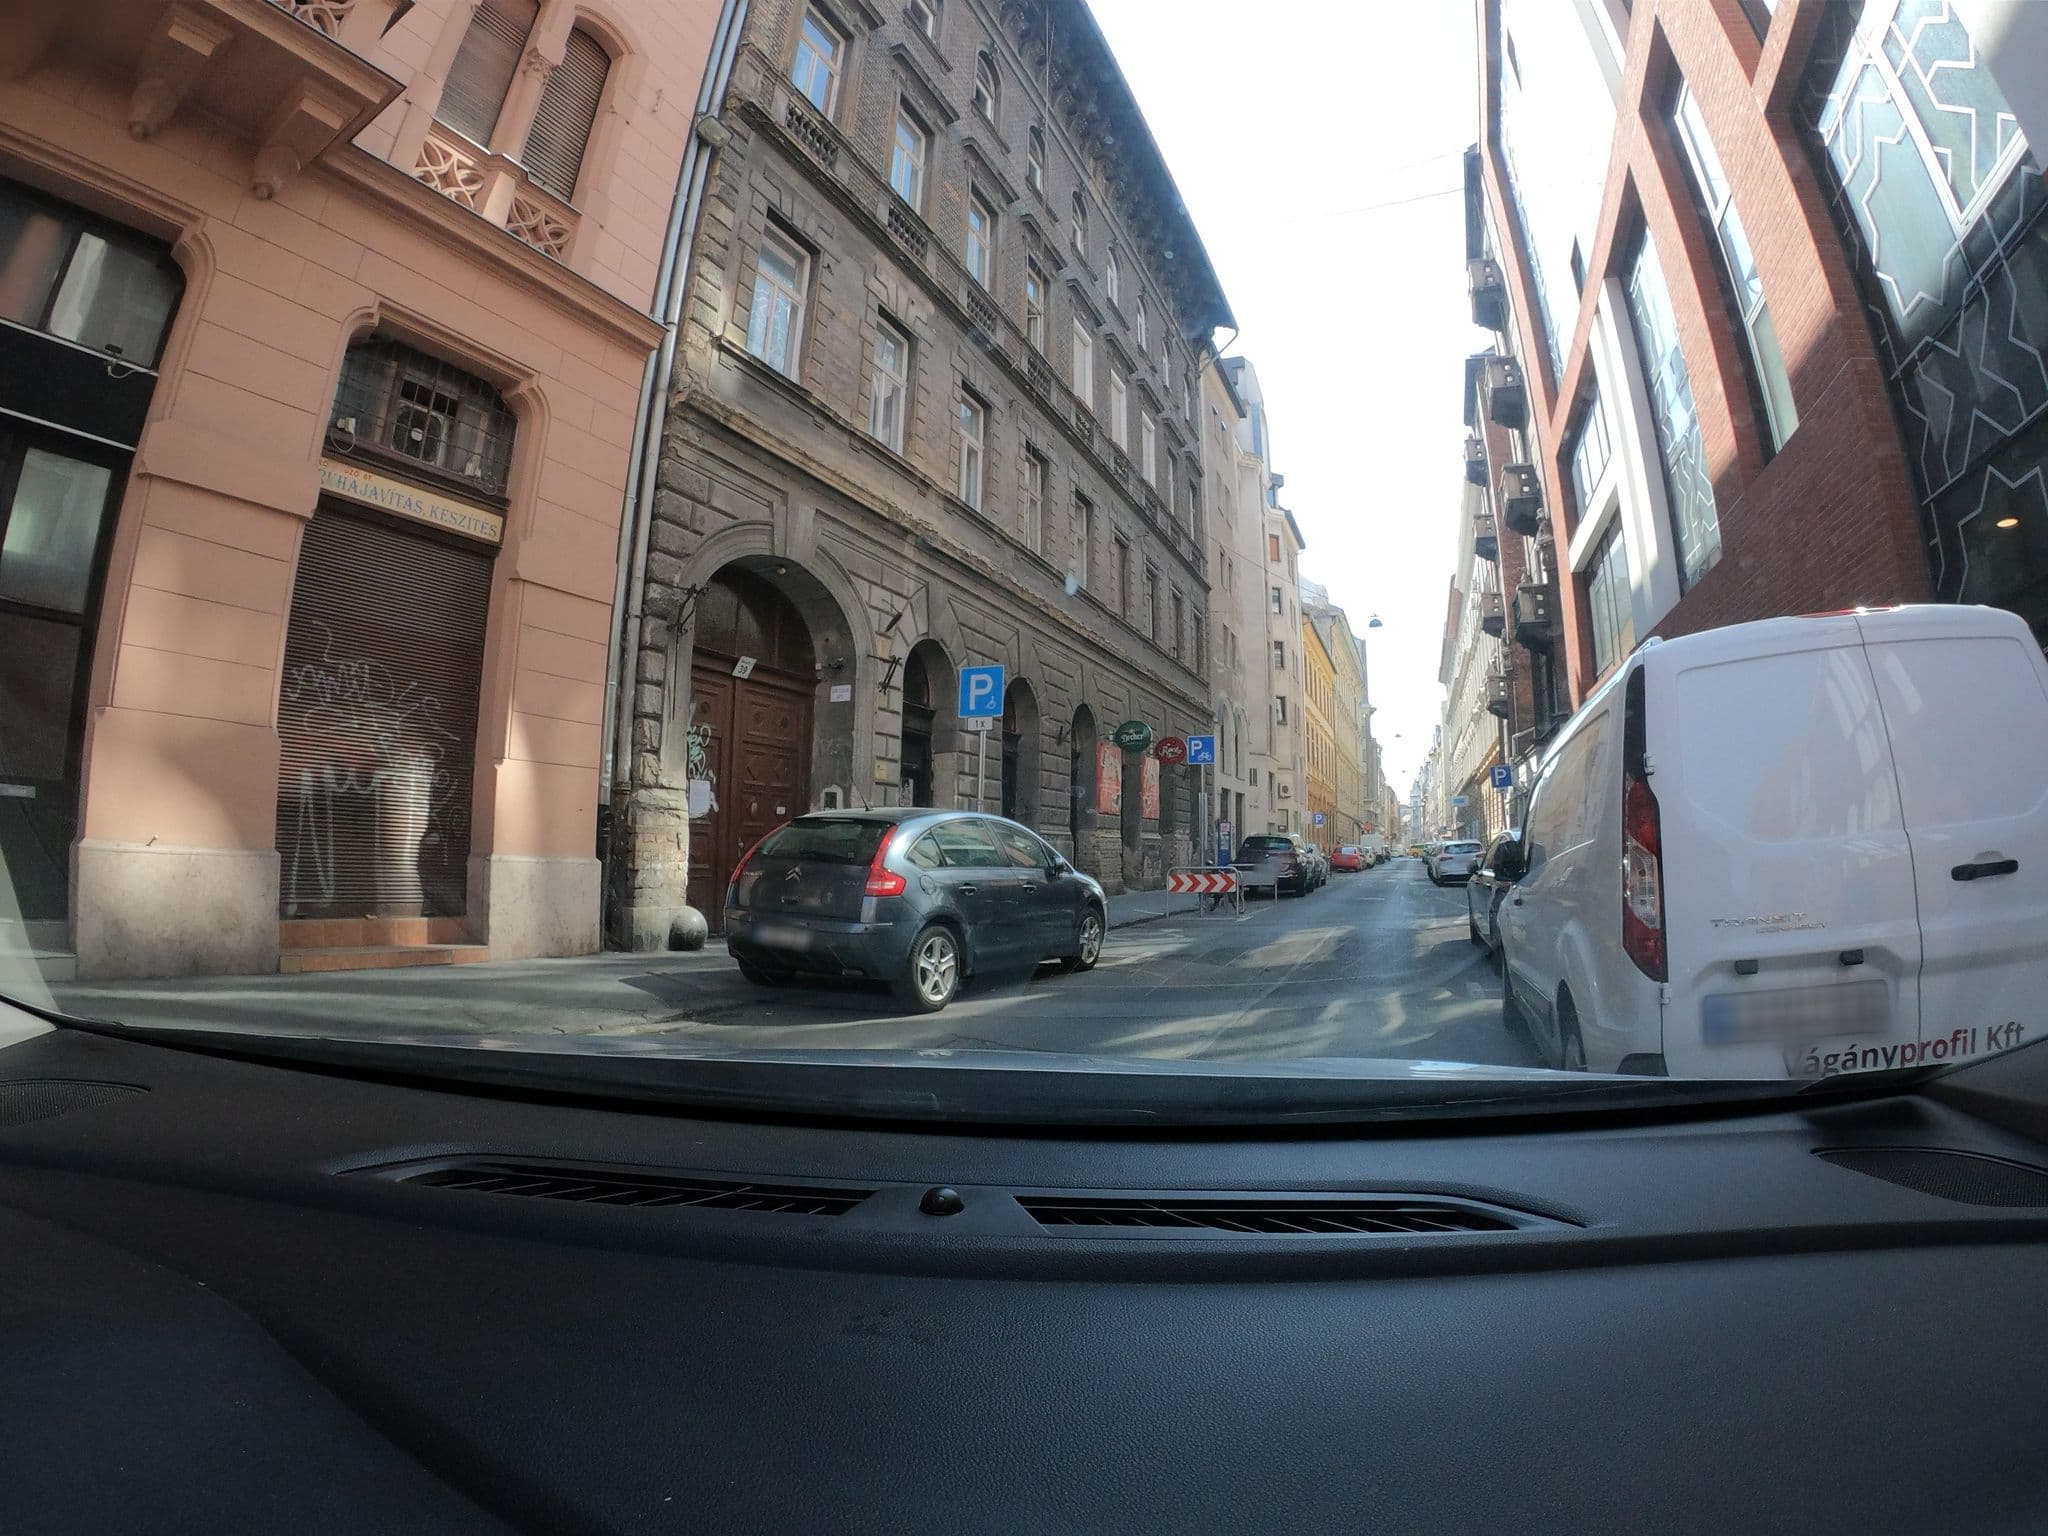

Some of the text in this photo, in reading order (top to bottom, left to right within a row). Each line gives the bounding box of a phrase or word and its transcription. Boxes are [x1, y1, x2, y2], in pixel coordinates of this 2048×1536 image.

[430, 502, 498, 538] KÉSZÍTÉS
[969, 673, 993, 711] P
[1191, 740, 1203, 756] P
[1494, 767, 1507, 786] P
[1315, 814, 1323, 823] P
[1986, 1020, 2026, 1051] Kft
